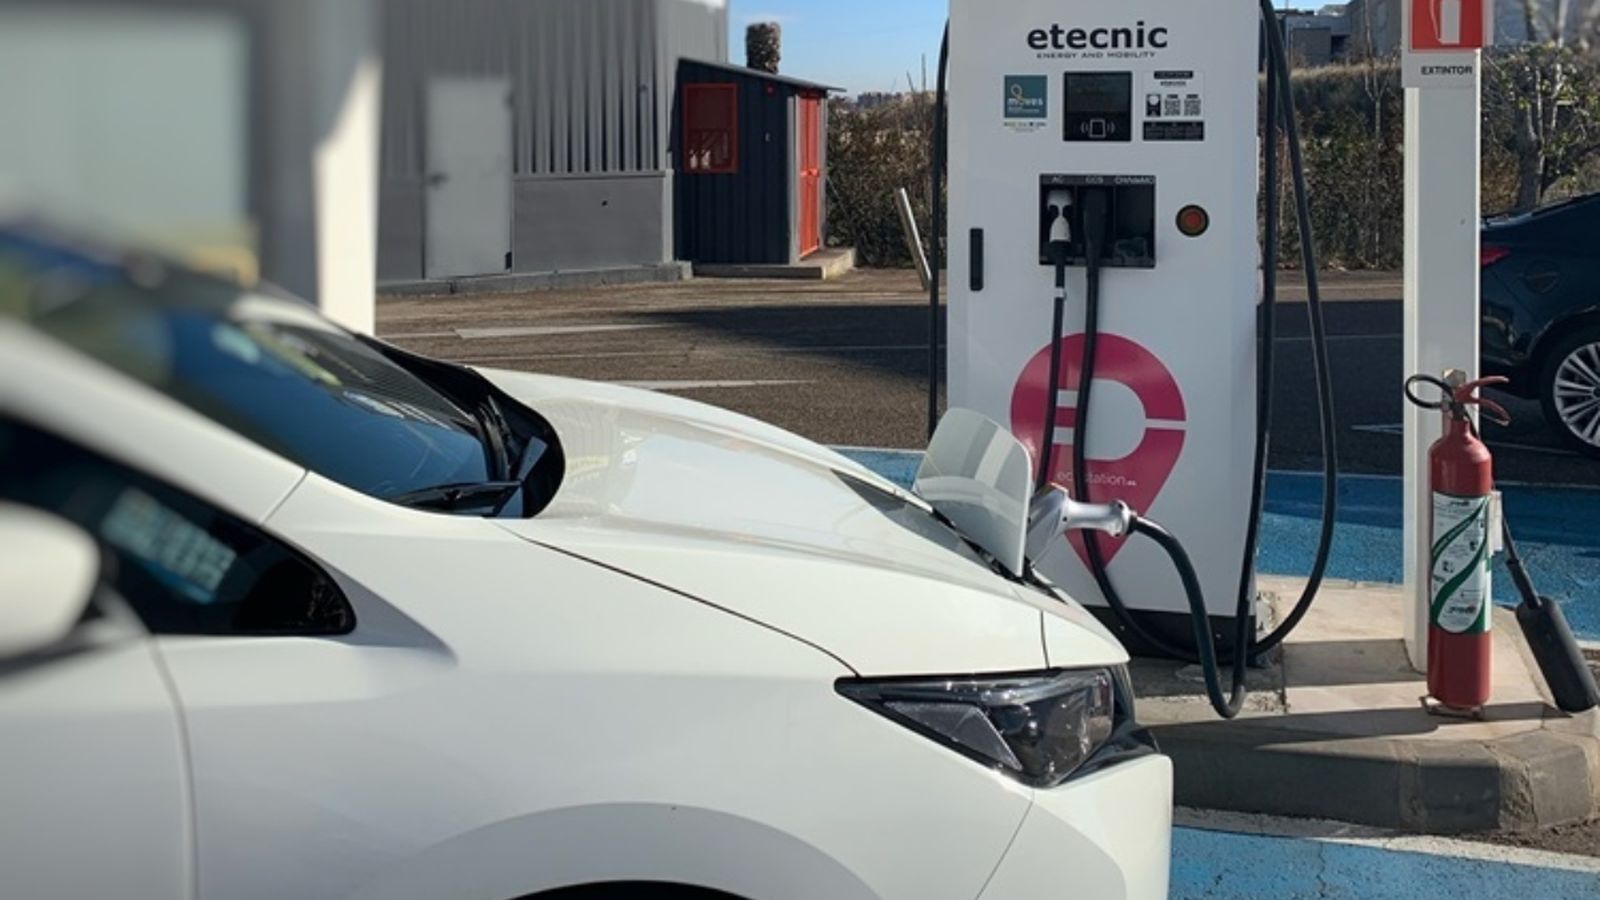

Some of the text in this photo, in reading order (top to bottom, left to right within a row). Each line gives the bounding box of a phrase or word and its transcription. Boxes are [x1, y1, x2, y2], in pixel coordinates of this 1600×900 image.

[1027, 21, 1168, 50] etecnic
[1421, 65, 1473, 75] EXTINTOR
[1057, 471, 1137, 486] ectation.es
